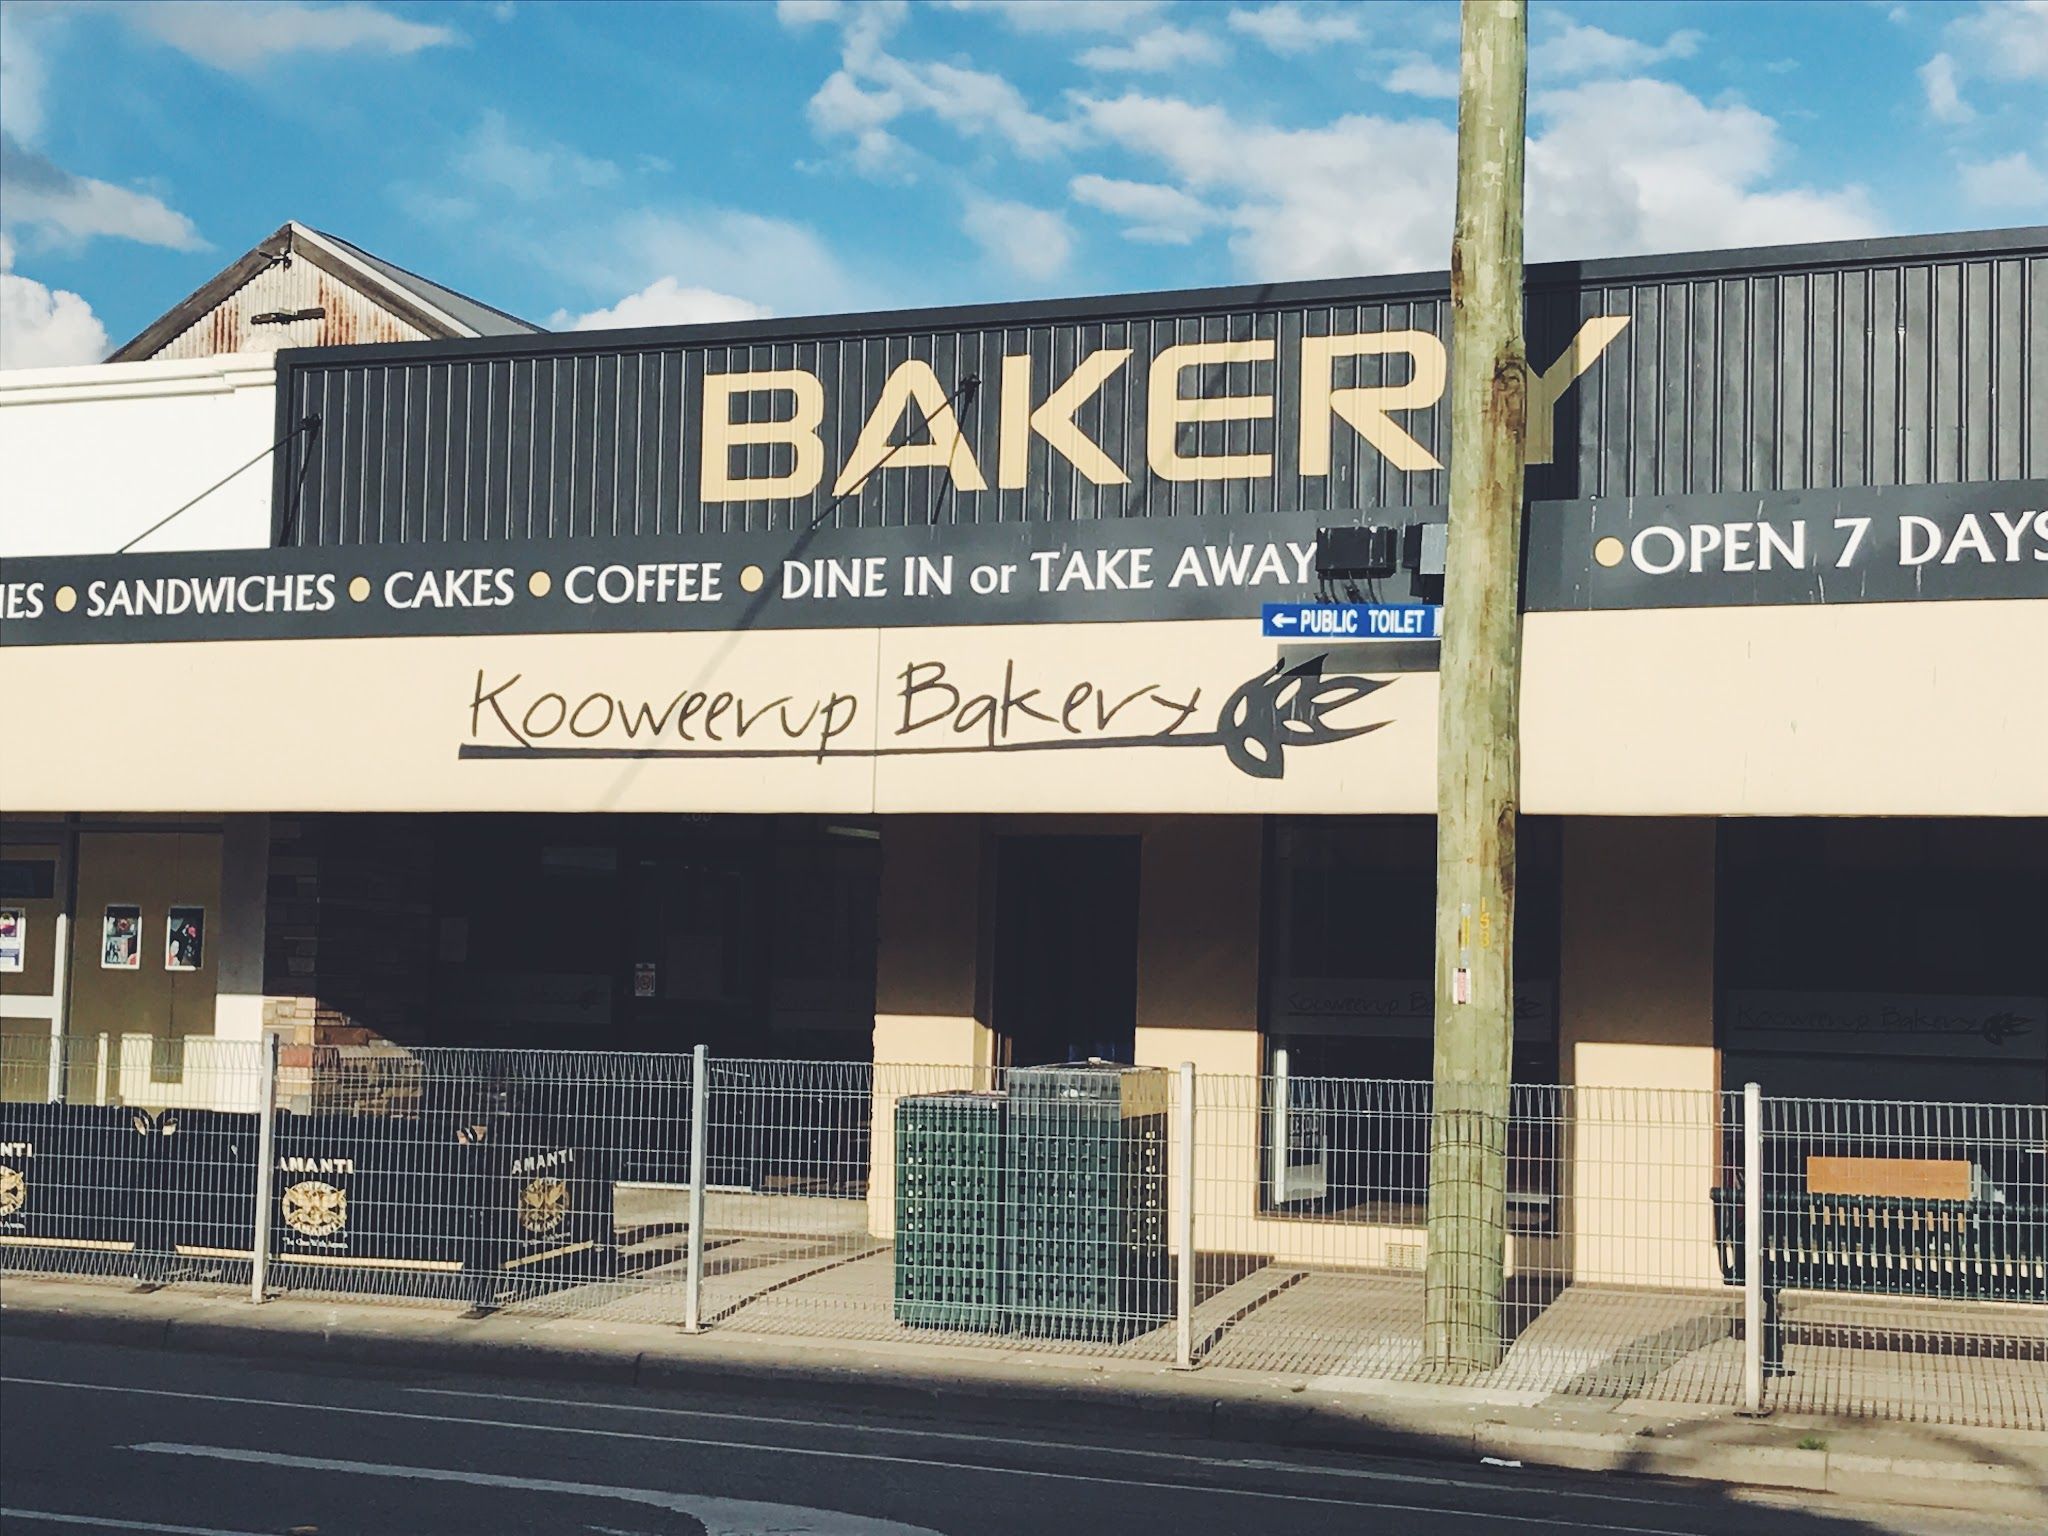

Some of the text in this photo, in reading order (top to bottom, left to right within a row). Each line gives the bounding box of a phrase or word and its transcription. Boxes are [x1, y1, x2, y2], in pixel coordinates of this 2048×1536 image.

[701, 315, 1630, 503] BAKERY
[1629, 521, 1806, 575] OPEN
[1834, 517, 1872, 568] 7
[87, 573, 336, 617] SANDWICHES
[384, 568, 514, 609] CAKES
[564, 562, 723, 604] COFFEE
[782, 557, 888, 599] DINE
[903, 555, 953, 596] IN
[969, 564, 1014, 595] or
[1029, 547, 1154, 592] TAKE
[1167, 542, 1317, 588] AWAY
[1300, 609, 1425, 633] PUBLIC TOILET
[470, 658, 1202, 765] Kooweerup Bakery
[0, 1142, 33, 1158] NTI
[279, 1156, 354, 1174] AMANTI
[511, 1147, 574, 1175] AMANTI
